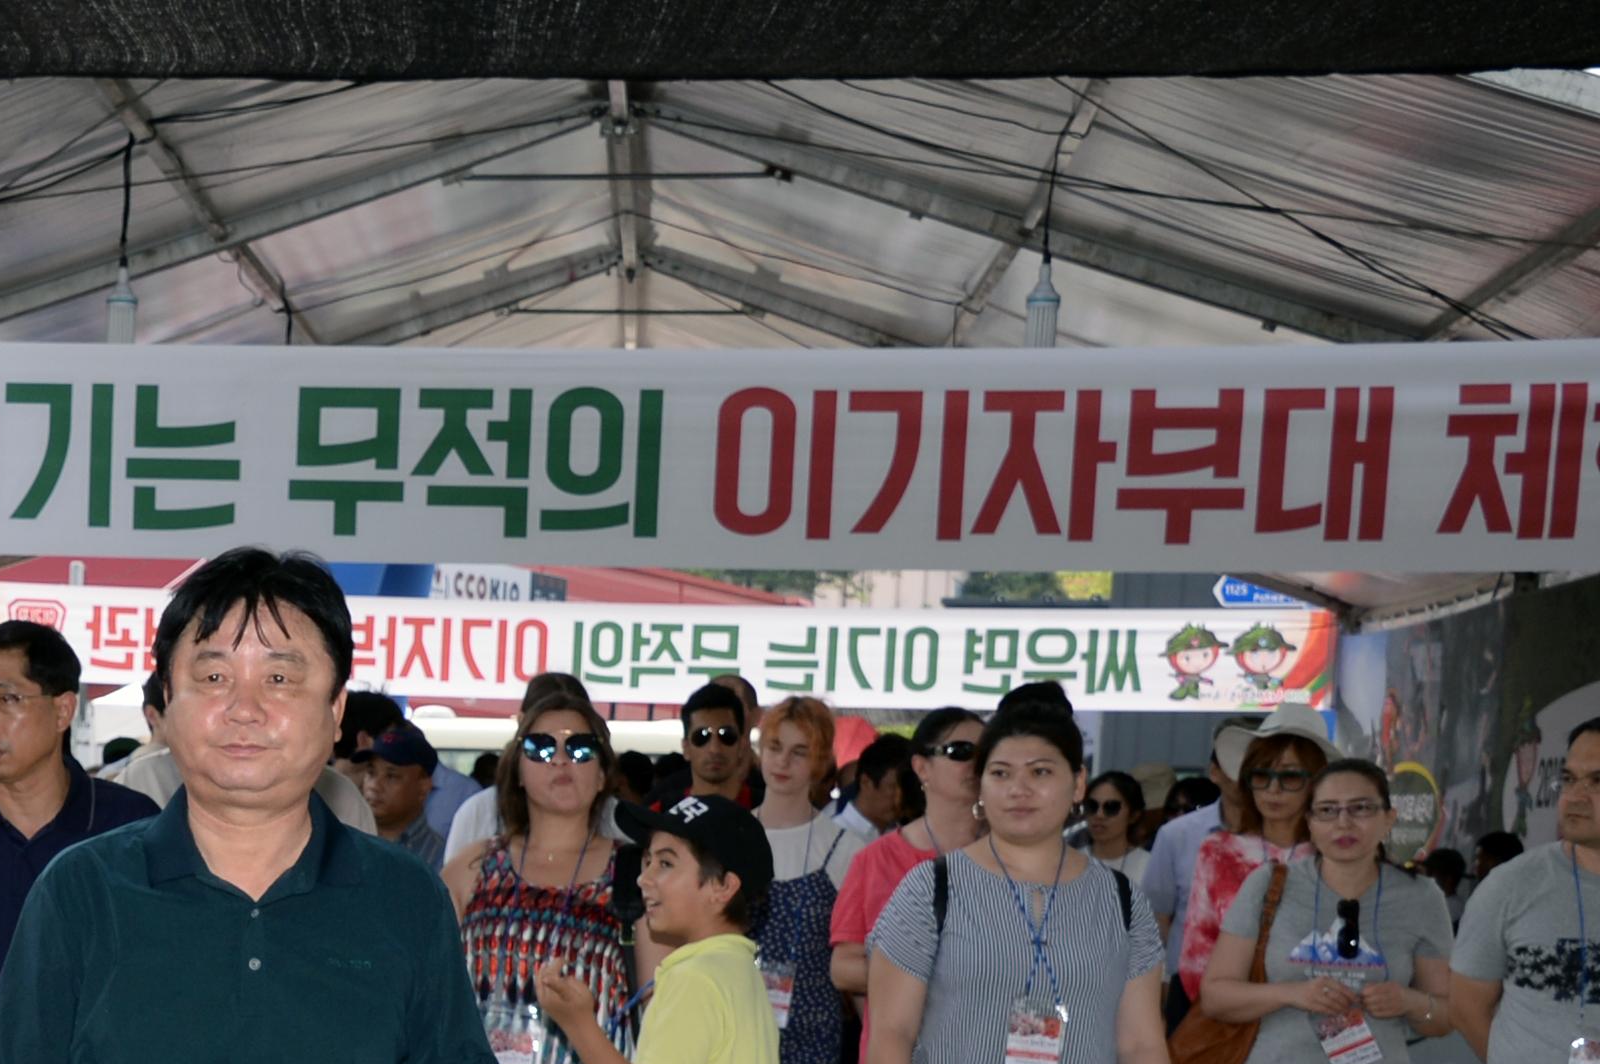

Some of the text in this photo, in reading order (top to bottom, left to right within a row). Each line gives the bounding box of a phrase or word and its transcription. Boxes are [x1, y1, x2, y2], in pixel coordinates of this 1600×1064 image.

[289, 386, 664, 538] 무적의
[713, 385, 1395, 545] 이기자부대
[1436, 382, 1600, 540] 체
